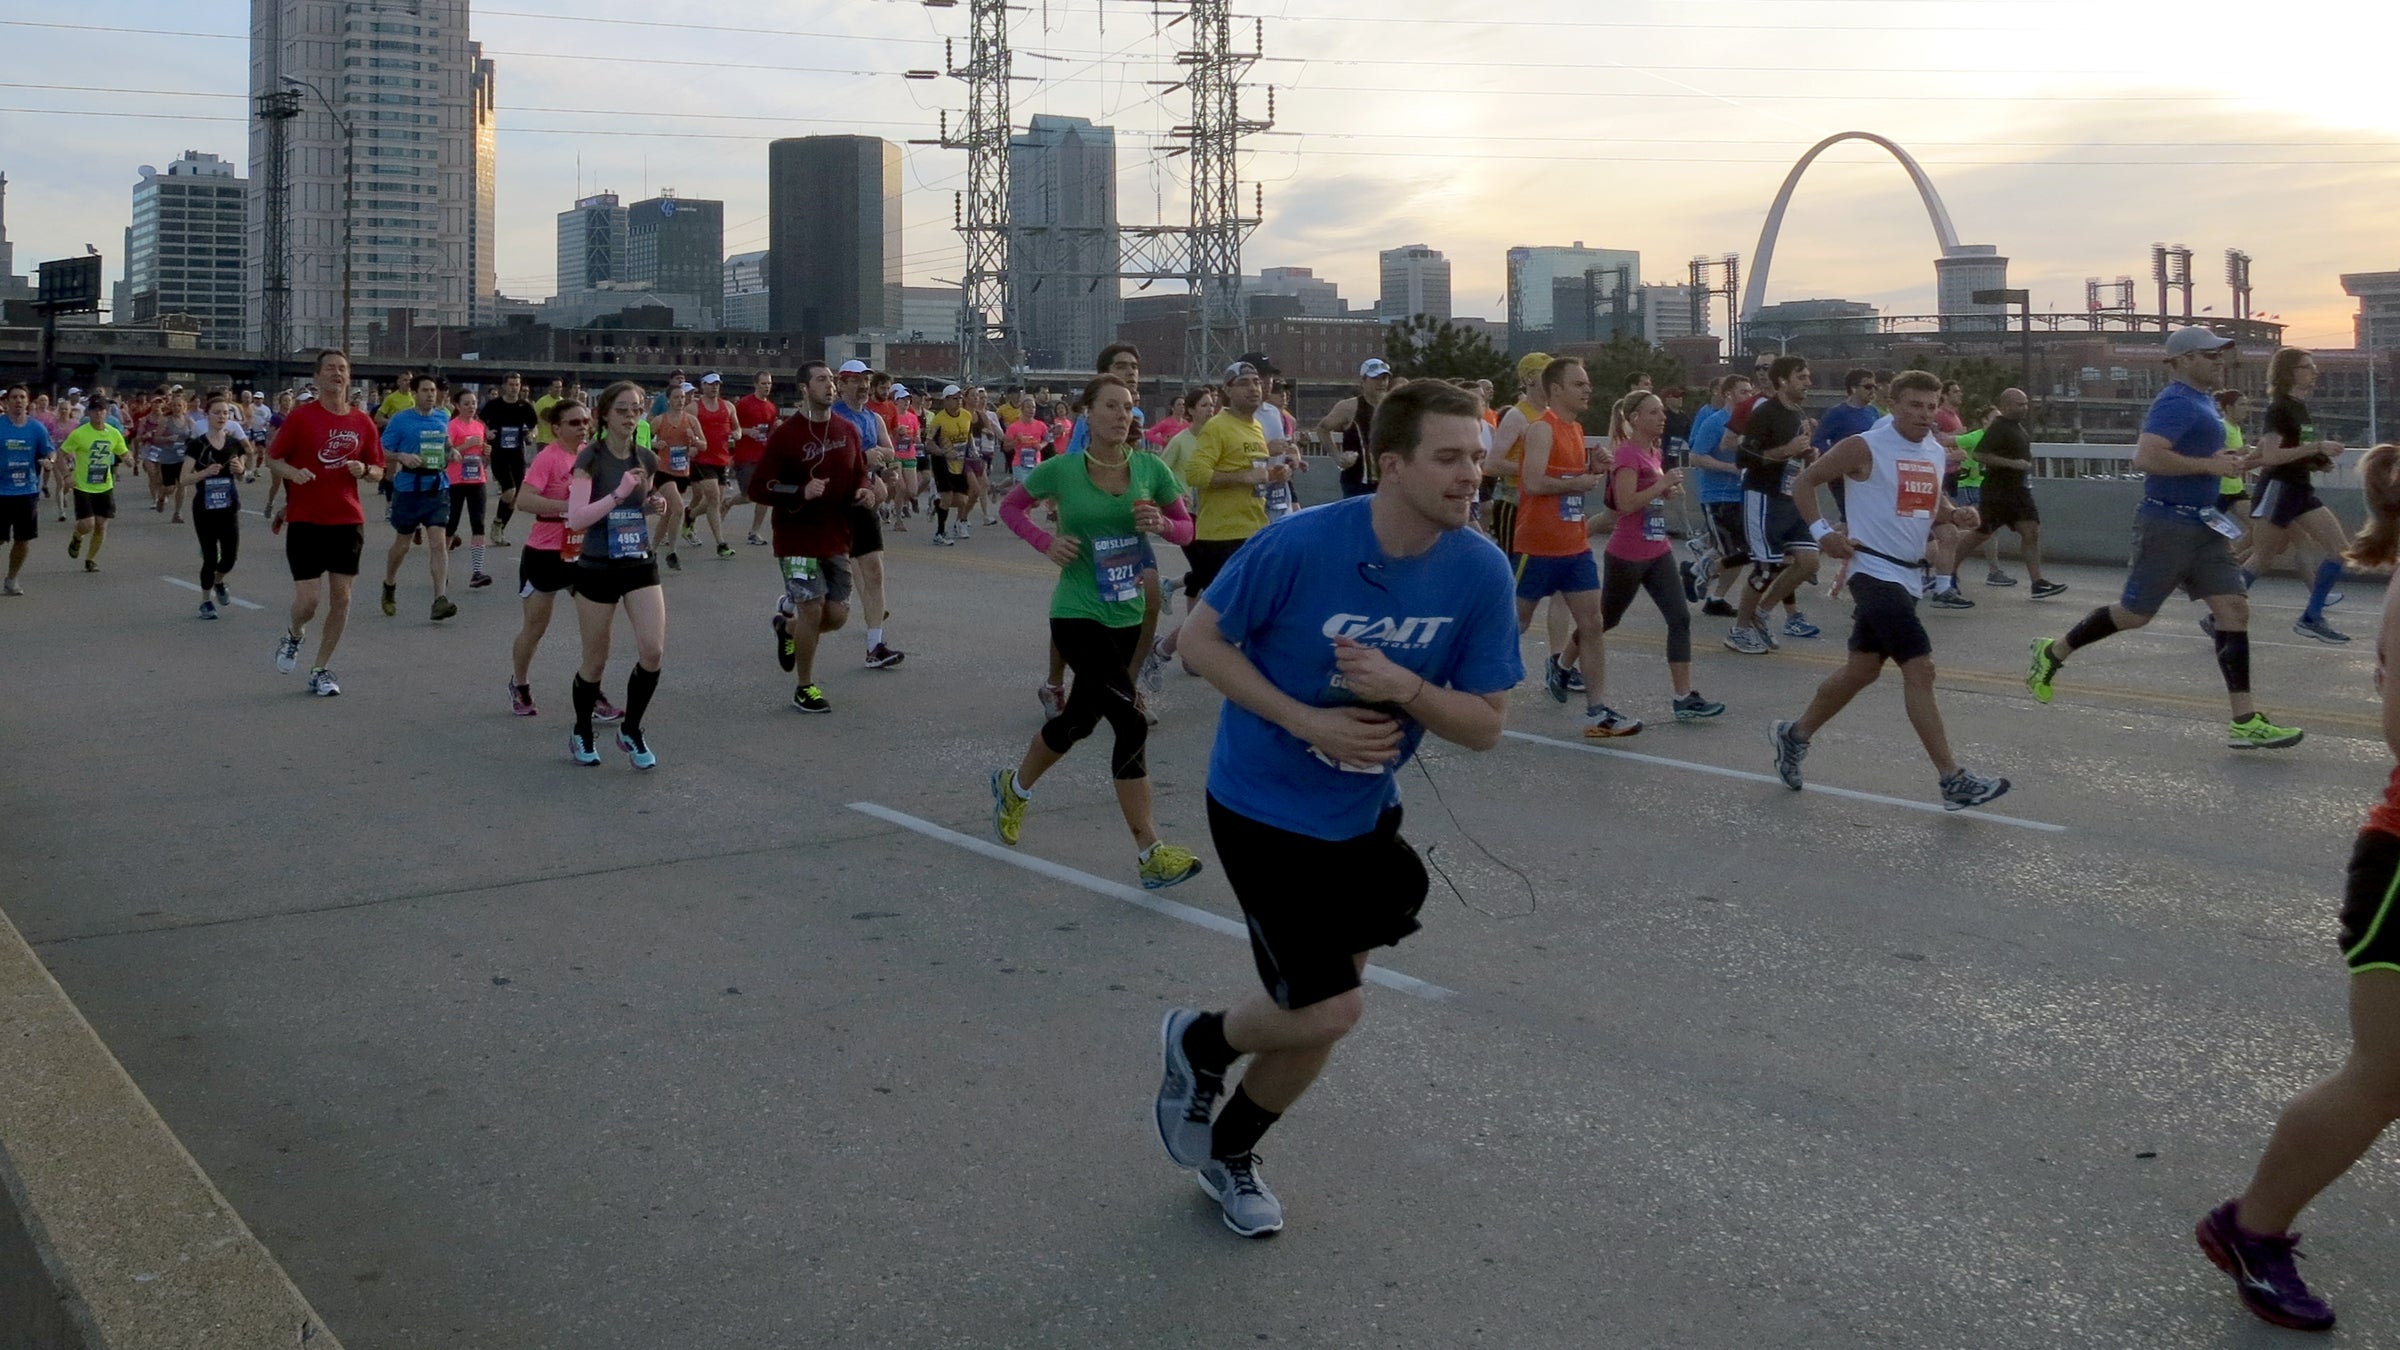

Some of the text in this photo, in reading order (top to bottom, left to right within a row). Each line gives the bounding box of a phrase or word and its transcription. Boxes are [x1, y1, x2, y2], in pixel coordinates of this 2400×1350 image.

[593, 345, 664, 354] GRAHAM
[682, 346, 738, 355] PAPER
[1904, 481, 1934, 494] 16122
[617, 532, 641, 544] 4963
[1107, 564, 1134, 582] 3271
[1322, 613, 1454, 643] GAIT
